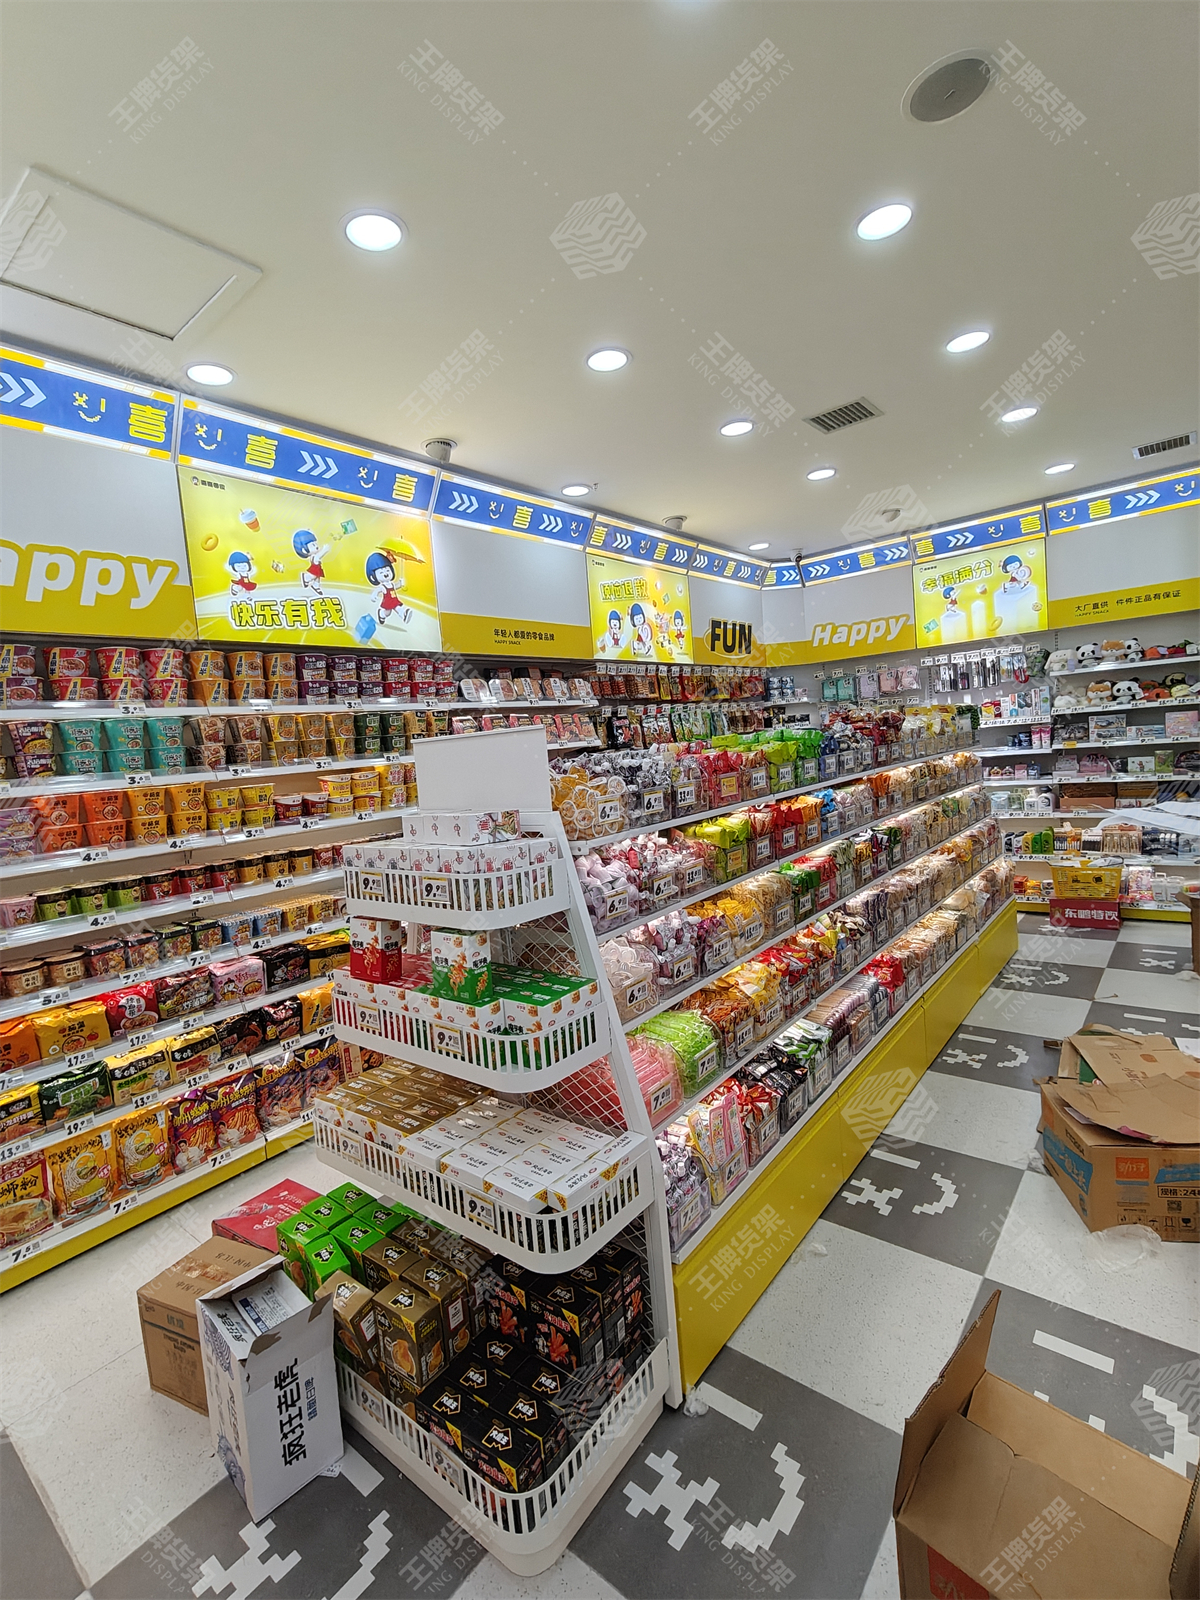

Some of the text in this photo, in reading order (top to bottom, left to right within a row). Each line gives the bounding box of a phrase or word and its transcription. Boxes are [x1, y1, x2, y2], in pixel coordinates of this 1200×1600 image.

[128, 402, 168, 443] 喜
[246, 434, 278, 469] 喜
[392, 473, 418, 502] 喜
[1088, 498, 1111, 518] 喜
[513, 506, 534, 528] 喜
[1020, 515, 1041, 532] 喜
[590, 526, 608, 547] 喜
[654, 543, 669, 560] 喜
[916, 539, 934, 555] 喜
[724, 561, 737, 575] 喜
[858, 552, 875, 568] 喜
[920, 560, 993, 592] 幸福满分
[599, 577, 649, 601] 烦恼退散
[1075, 590, 1181, 612] 大厂直供 件件正品有保证
[230, 598, 347, 629] 快乐有我
[494, 629, 554, 641] 年轻人都爱的零食品牌
[710, 619, 752, 655] FUN
[813, 614, 910, 647] Happy
[646, 797, 656, 810] 6.9
[600, 804, 614, 820] 6.9
[362, 878, 376, 890] 9.9
[424, 883, 440, 897] 9.9
[655, 880, 667, 894] 6.9
[608, 895, 622, 913] 6.9
[90, 916, 107, 926] 4.9
[1064, 908, 1119, 922] 东鹏特饮
[675, 961, 688, 976] 6.9
[629, 987, 641, 1003] 6.9
[360, 1011, 374, 1024] 9.9
[437, 1031, 453, 1046] 9.9
[469, 1200, 485, 1216] 9.9
[539, 1376, 557, 1390] 大魔王
[441, 1396, 458, 1410] 大魔王
[516, 1403, 534, 1416] 大魔王
[274, 1358, 306, 1467] 疯狂老虎
[490, 1430, 509, 1445] 大魔王
